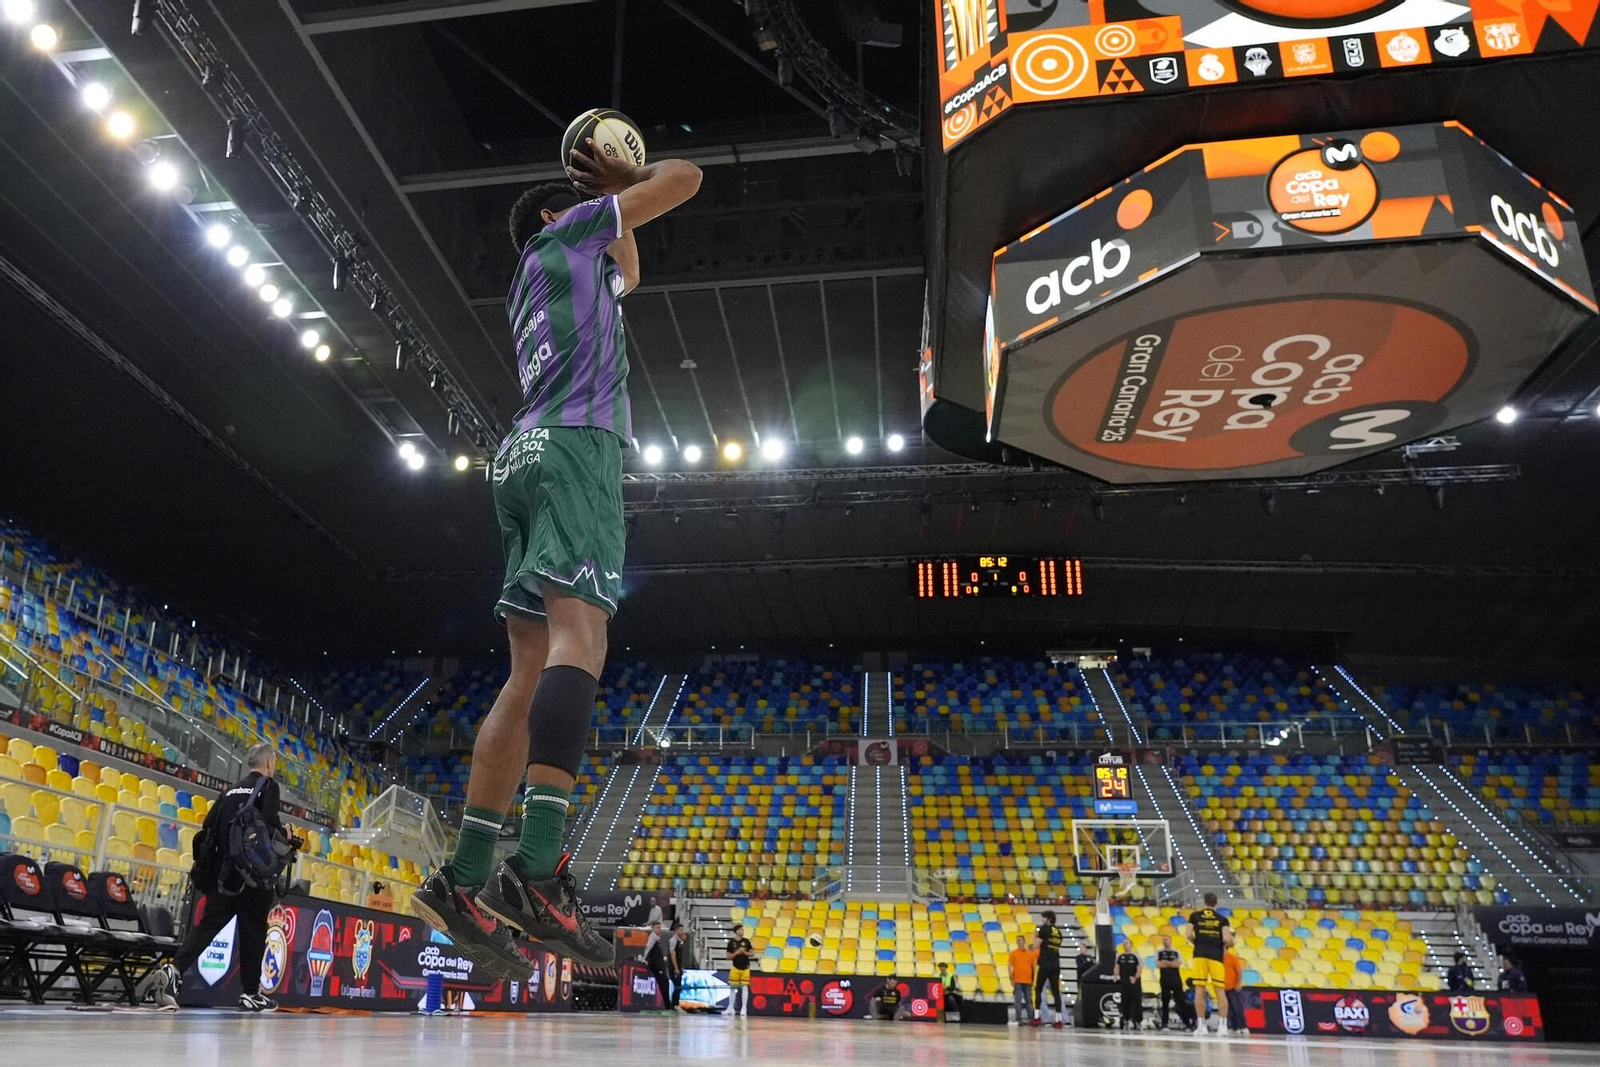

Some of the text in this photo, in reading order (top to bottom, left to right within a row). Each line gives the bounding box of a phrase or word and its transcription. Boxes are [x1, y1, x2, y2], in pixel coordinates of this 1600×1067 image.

[944, 63, 1007, 114] #CopaACB
[1295, 169, 1323, 181] acb
[1285, 178, 1340, 195] Copa
[1313, 192, 1350, 208] Rey
[1491, 194, 1559, 268] acb
[1026, 238, 1131, 315] acb
[1126, 334, 1162, 373] Gran
[1223, 334, 1331, 430] Copa
[1303, 354, 1364, 405] acb
[1108, 375, 1147, 427] Canaria
[1135, 344, 1246, 442] del Rey
[510, 440, 545, 463] DEL SOL
[49, 724, 82, 741] #CopaACB
[1101, 779, 1127, 797] 24
[591, 905, 606, 913] del
[607, 904, 630, 917] Rey
[1506, 914, 1530, 924] acb
[1498, 920, 1595, 938] Copa del Rey
[1511, 936, 1532, 944] Gran
[1533, 936, 1568, 945] Canaria
[425, 945, 440, 956] acb
[418, 951, 474, 973] Copa del Rey
[1334, 1006, 1369, 1019] BAXI
